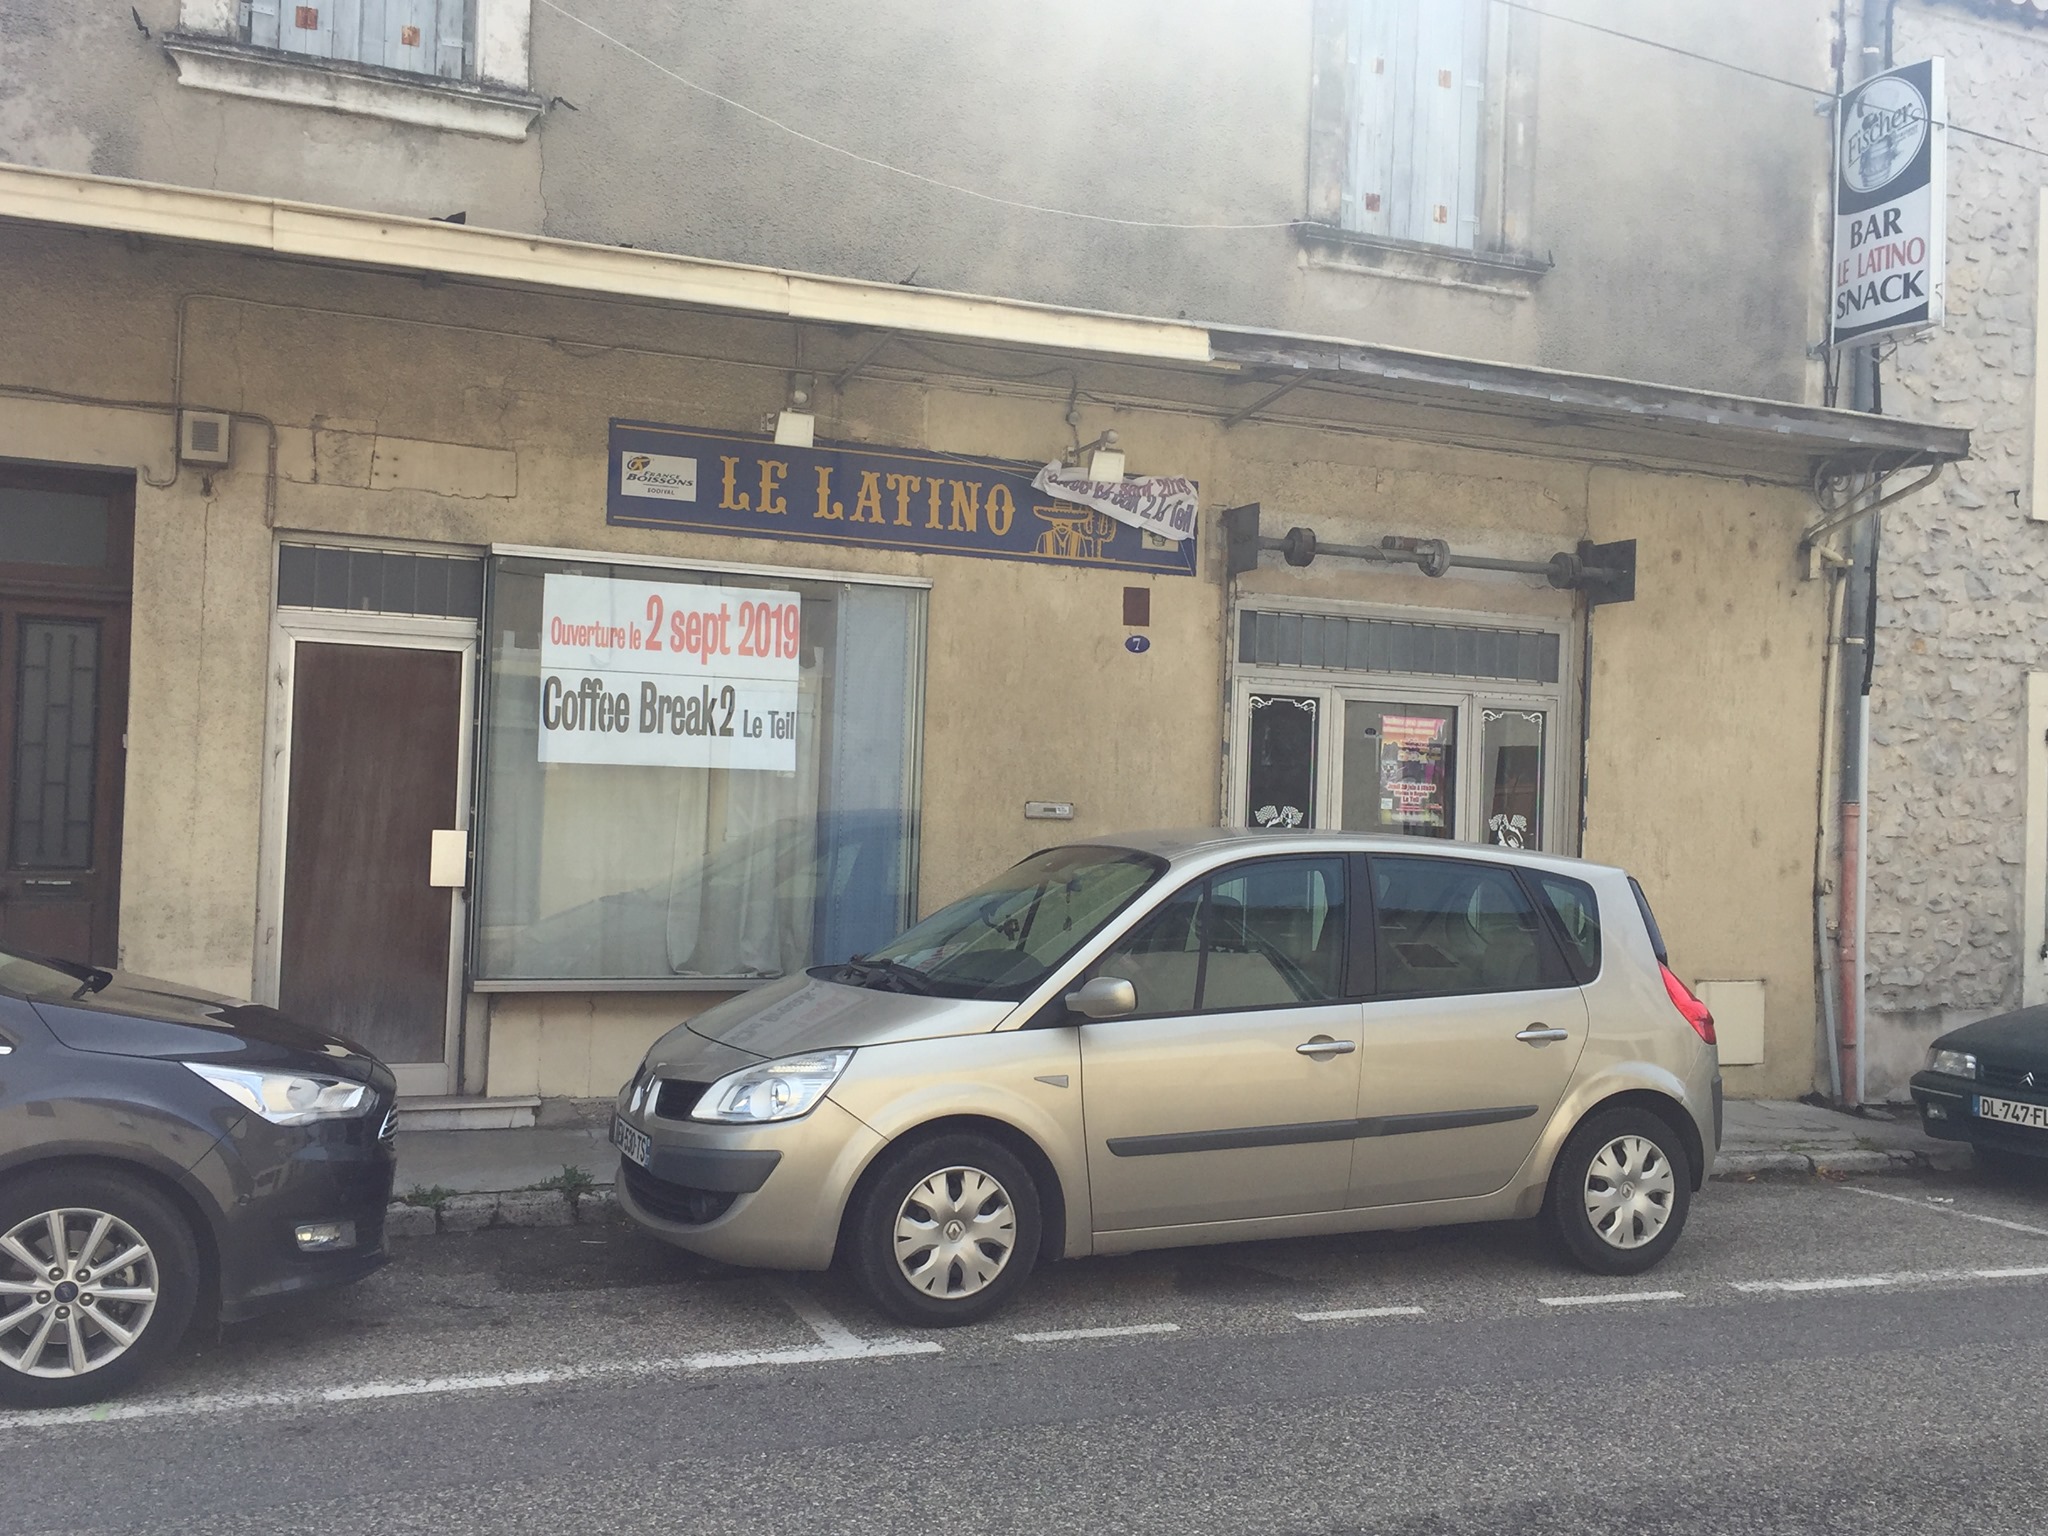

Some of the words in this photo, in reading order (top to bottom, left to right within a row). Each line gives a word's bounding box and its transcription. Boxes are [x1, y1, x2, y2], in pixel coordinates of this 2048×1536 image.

[1848, 101, 1914, 163] Fischer
[1850, 207, 1903, 250] BAR
[1837, 258, 1850, 288] LE
[1857, 236, 1926, 279] LATINO
[1836, 269, 1925, 321] SNACK
[626, 473, 693, 486] BOISSONS
[643, 471, 680, 480] FRANCE
[718, 455, 789, 515] LE
[813, 465, 1017, 536] LATINO
[551, 615, 625, 650] Ouverture
[629, 621, 642, 650] le
[645, 594, 664, 651] 2
[670, 602, 731, 666] sept
[737, 600, 799, 660] 2019
[1132, 637, 1141, 651] 7
[542, 675, 630, 733] Coffee
[743, 709, 763, 739] Le
[768, 710, 796, 740] Teil
